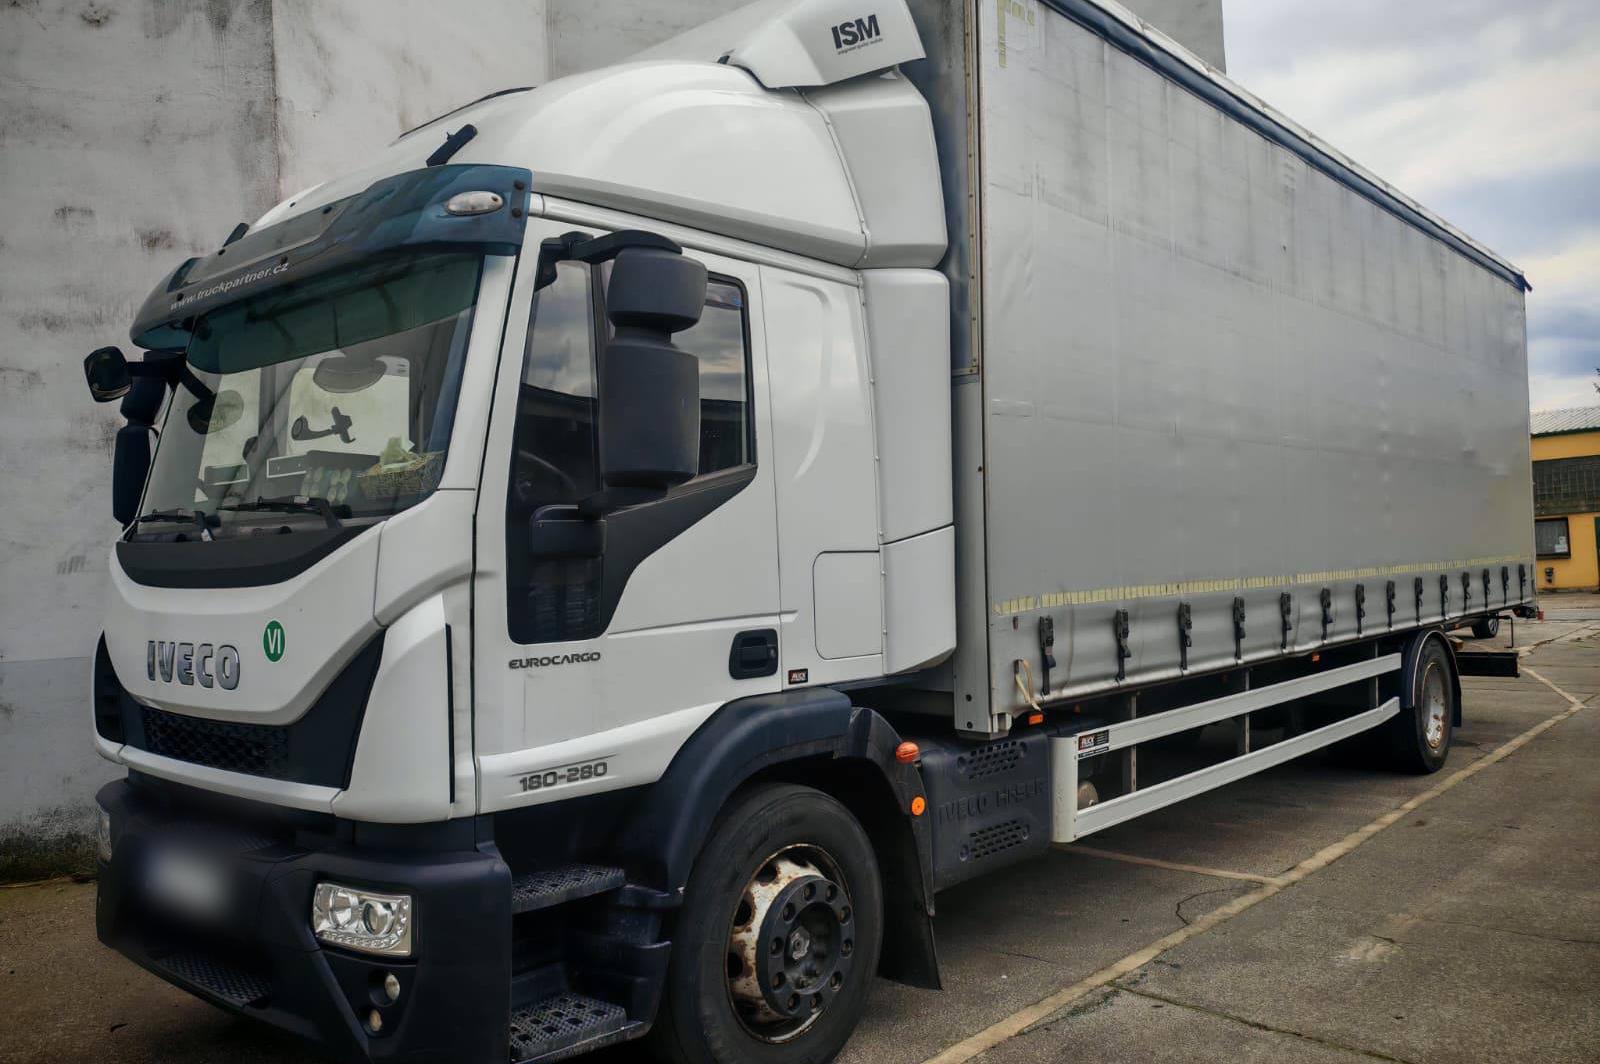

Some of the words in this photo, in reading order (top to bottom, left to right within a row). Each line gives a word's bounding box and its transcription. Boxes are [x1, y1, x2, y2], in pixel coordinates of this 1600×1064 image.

[832, 14, 880, 49] ISM
[170, 263, 289, 311] www.truckpartner.cz
[147, 640, 240, 691] IVECO
[509, 652, 601, 669] EUROCARGO
[520, 762, 607, 792] 180-280
